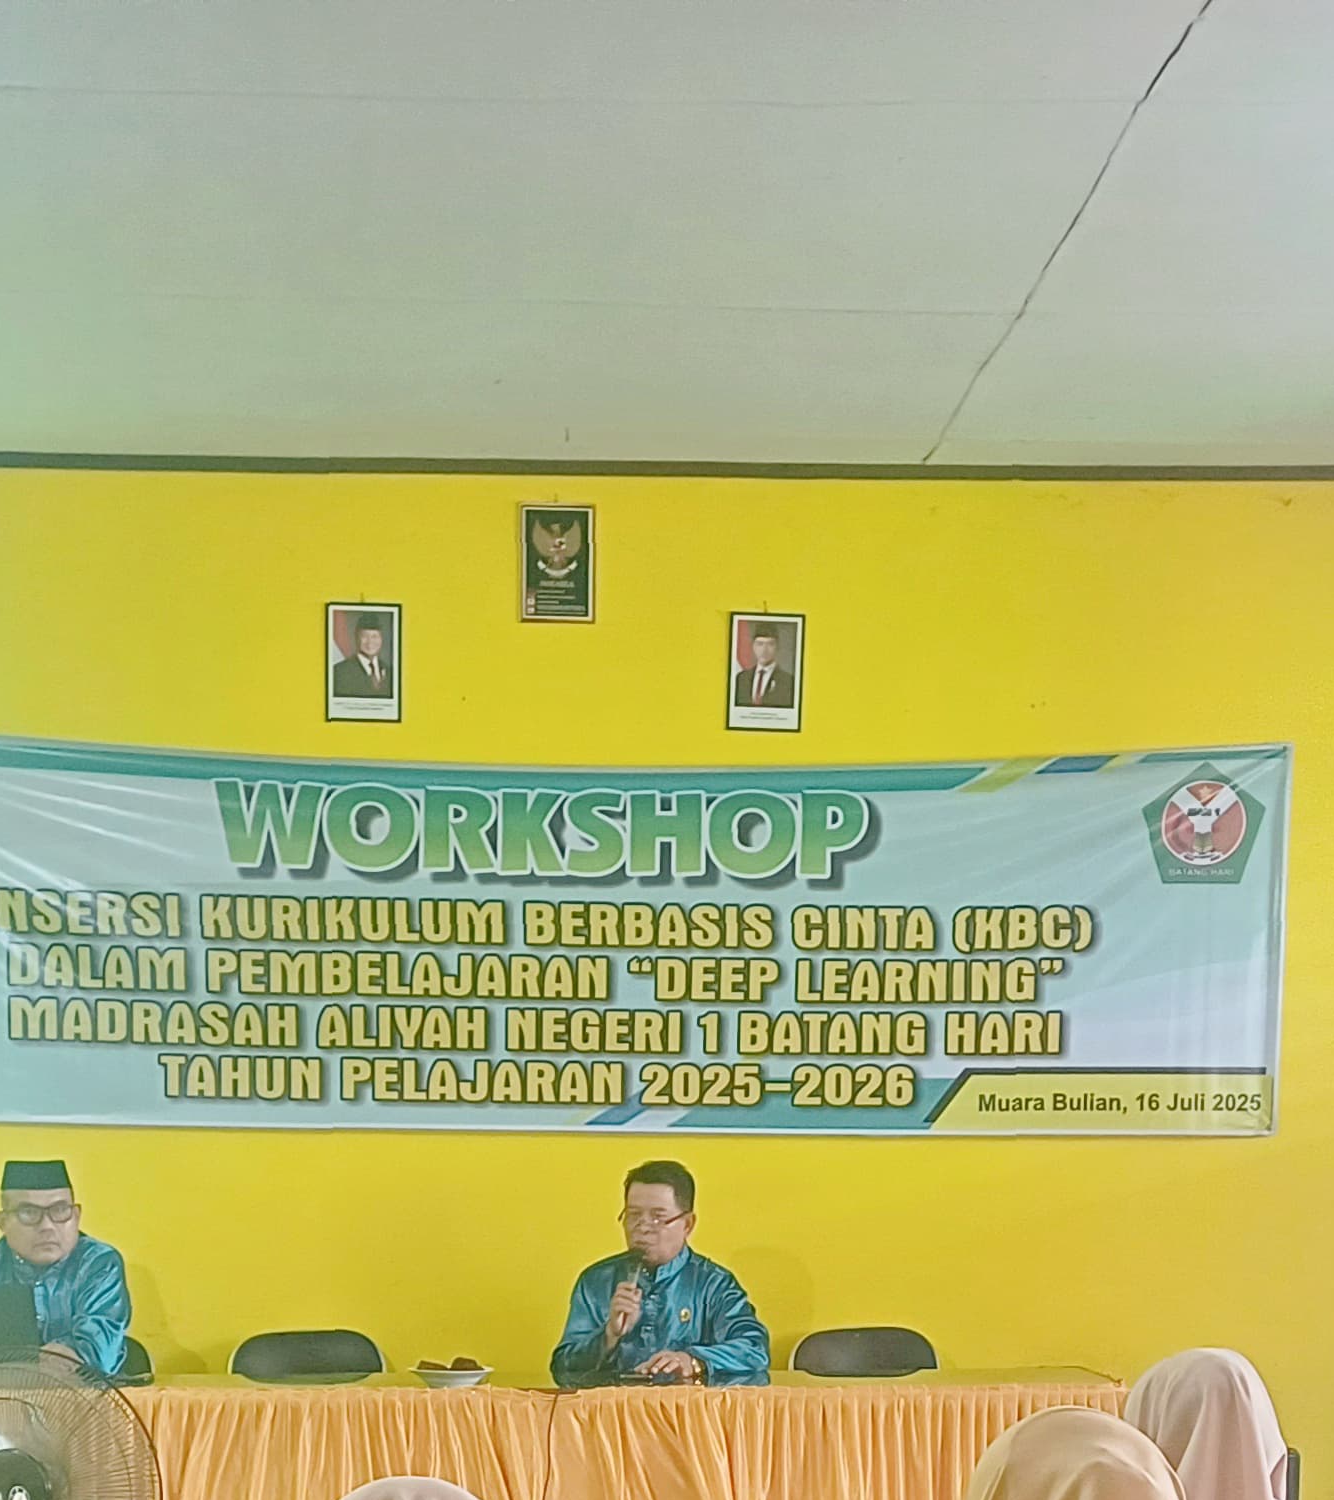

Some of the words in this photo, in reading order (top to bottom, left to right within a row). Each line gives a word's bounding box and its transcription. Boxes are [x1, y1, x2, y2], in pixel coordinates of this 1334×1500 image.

[212, 777, 872, 880] WORKSHOP
[199, 894, 507, 945] KURIKULUM
[523, 900, 774, 950] BERBASIS
[792, 905, 936, 951] CINTA
[952, 905, 1094, 954] (KBC)
[5, 941, 187, 992] DALAM
[207, 948, 609, 1002] PEMBELAJARAN
[7, 996, 299, 1048] MADRASAH
[315, 1003, 487, 1051] ALIYAH
[505, 1007, 682, 1054] NEGERI
[695, 1011, 722, 1055] 1
[738, 1010, 927, 1057] BATANG
[943, 1011, 1063, 1055] HARI
[158, 1053, 322, 1101] TAHUN
[341, 1055, 624, 1106] PELAJARAN
[978, 1092, 1046, 1113] Muara
[1051, 1091, 1129, 1115] Bulian,
[1134, 1092, 1161, 1112] 16
[1166, 1092, 1206, 1112] Juli
[1211, 1093, 1263, 1113] 2025
